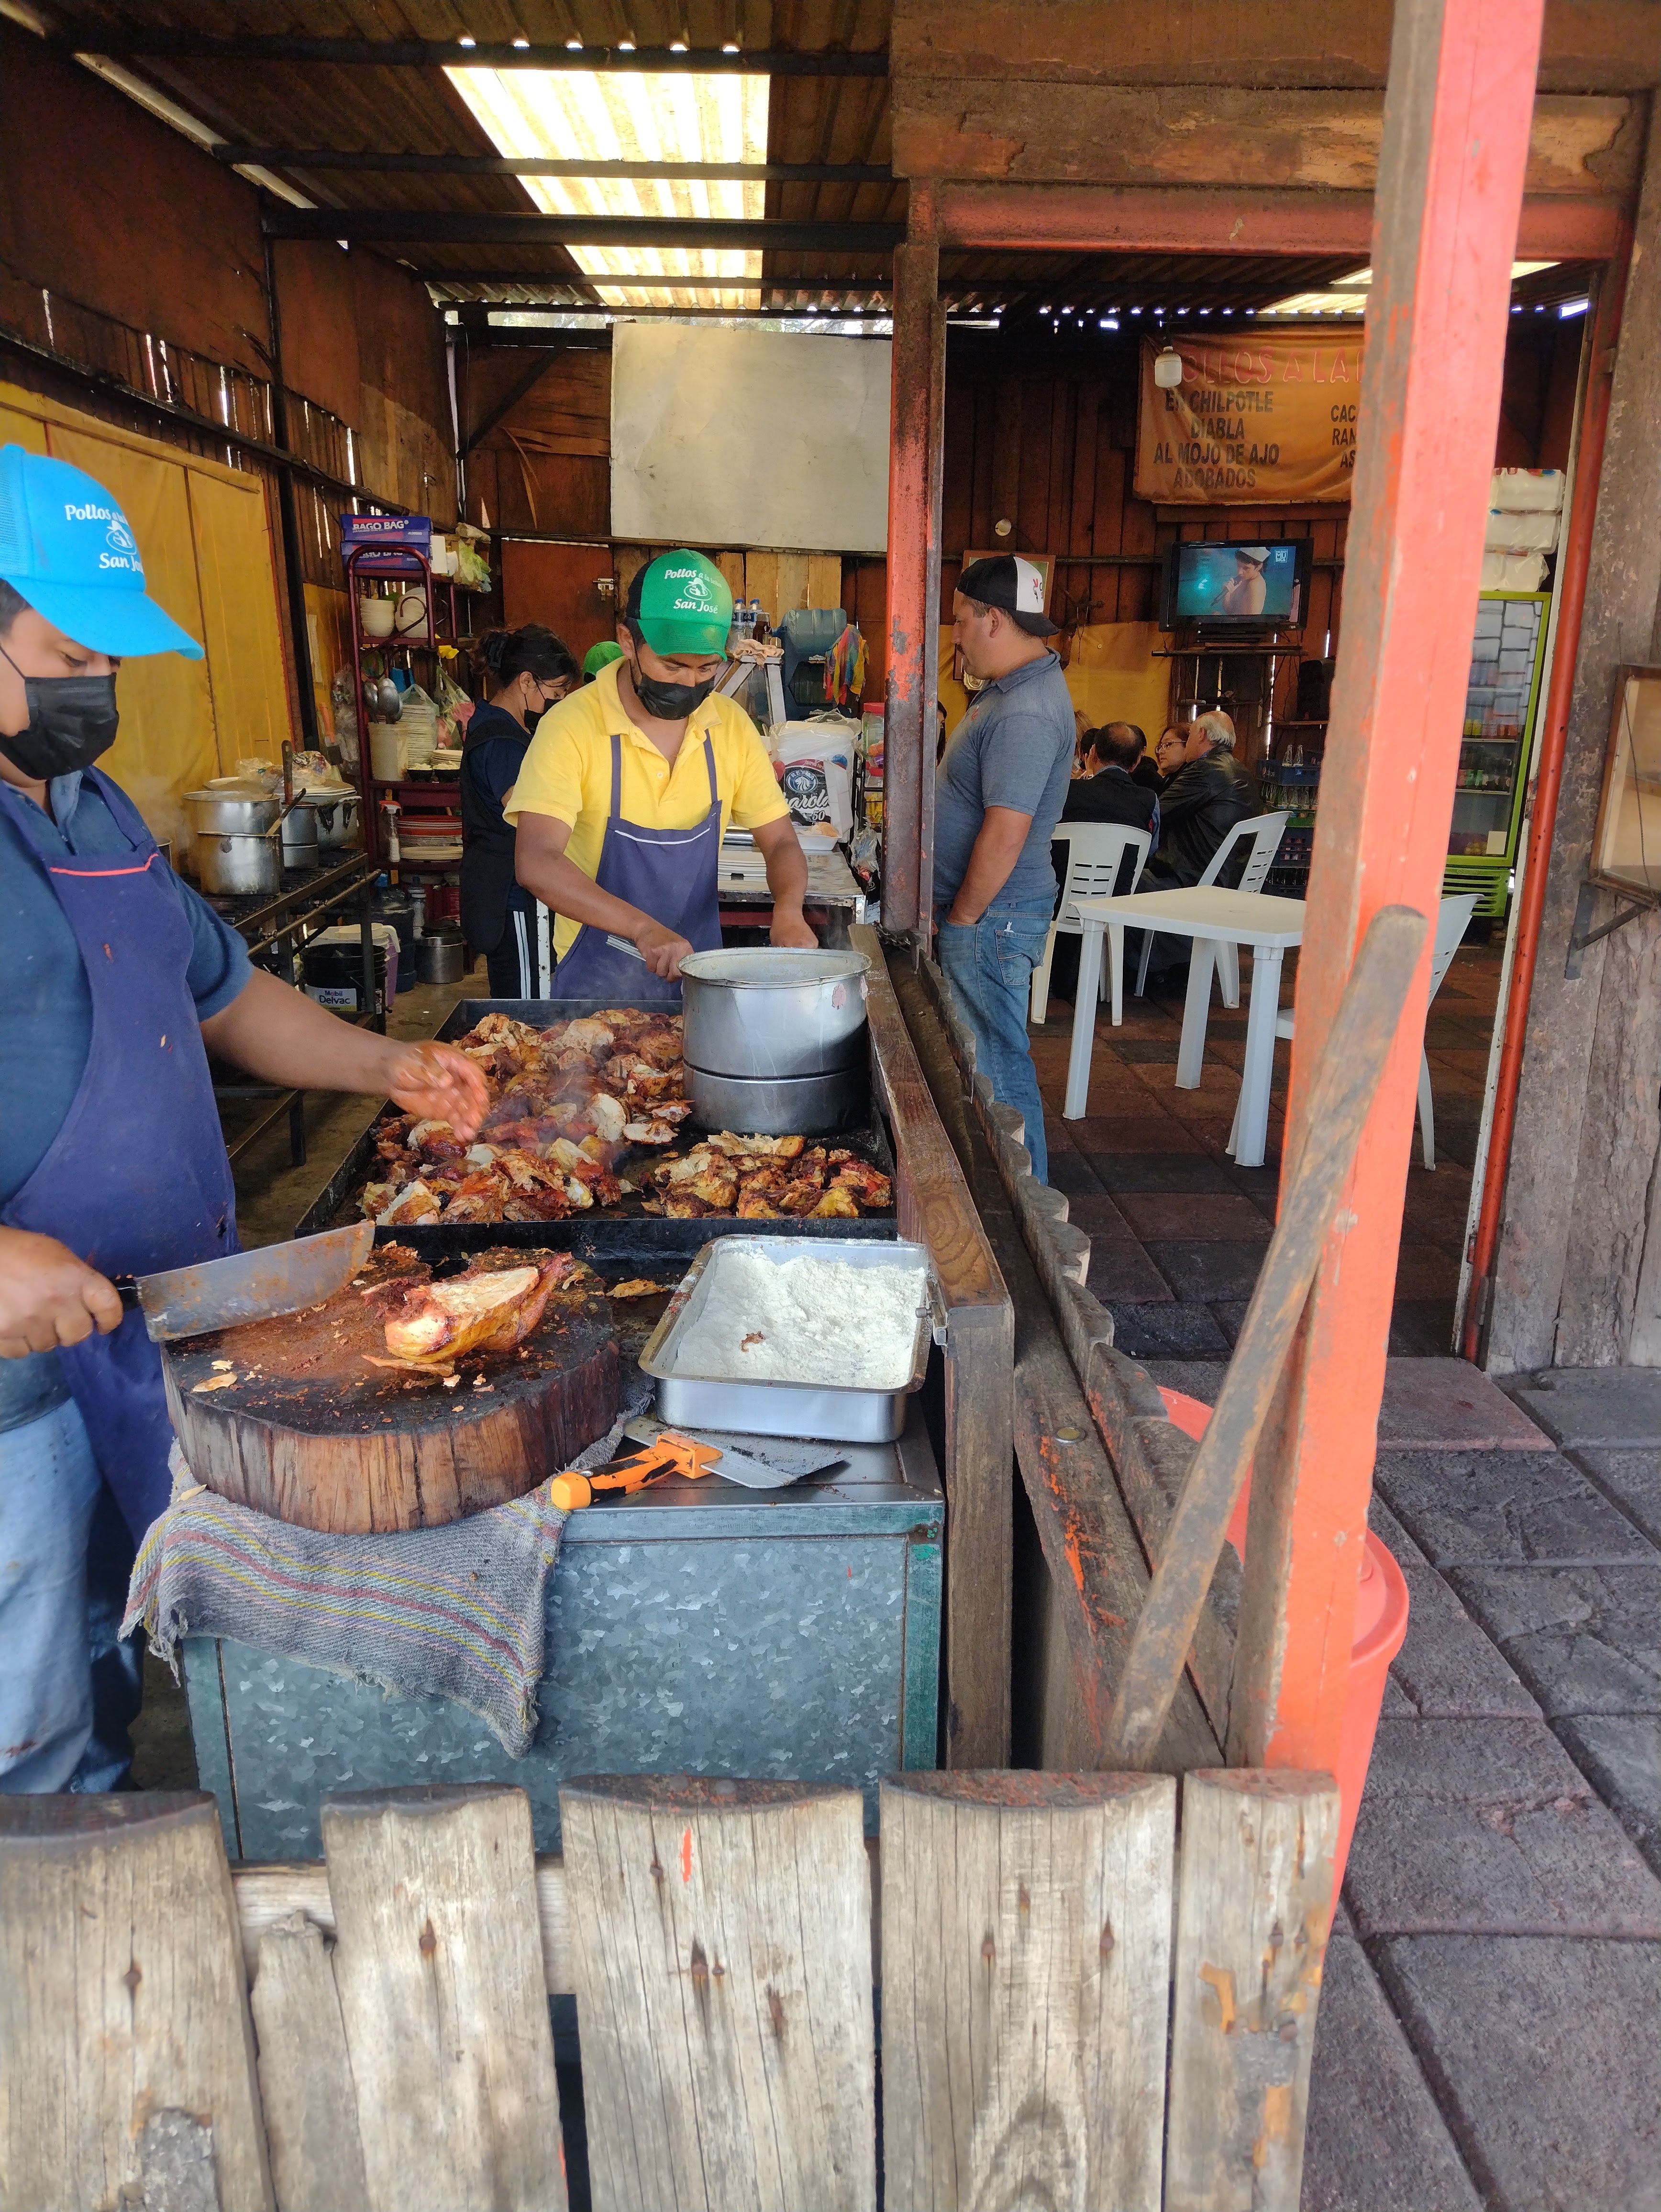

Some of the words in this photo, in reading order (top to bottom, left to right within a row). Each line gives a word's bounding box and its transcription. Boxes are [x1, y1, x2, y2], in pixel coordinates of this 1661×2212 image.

[1179, 345, 1274, 384] OLLOS
[1283, 348, 1302, 382] A
[1189, 390, 1273, 413] CHILPOTLE
[1330, 404, 1358, 423] CAC
[1190, 418, 1245, 439] DIABLA
[1153, 442, 1173, 465] AL
[1178, 442, 1220, 465] MOJO
[1226, 443, 1245, 465] DE
[1249, 443, 1280, 465] AJO
[1173, 467, 1256, 490] ADOBADOS
[65, 504, 111, 520] Pollos
[352, 522, 382, 530] BAGO
[384, 520, 404, 530] BAG
[99, 553, 130, 569] San
[130, 555, 144, 575] Jo
[664, 568, 697, 579] Pollos
[673, 598, 697, 609] San
[697, 601, 719, 614] José
[783, 789, 830, 809] arola
[812, 810, 825, 820] 50
[319, 995, 351, 1004] Delvac
